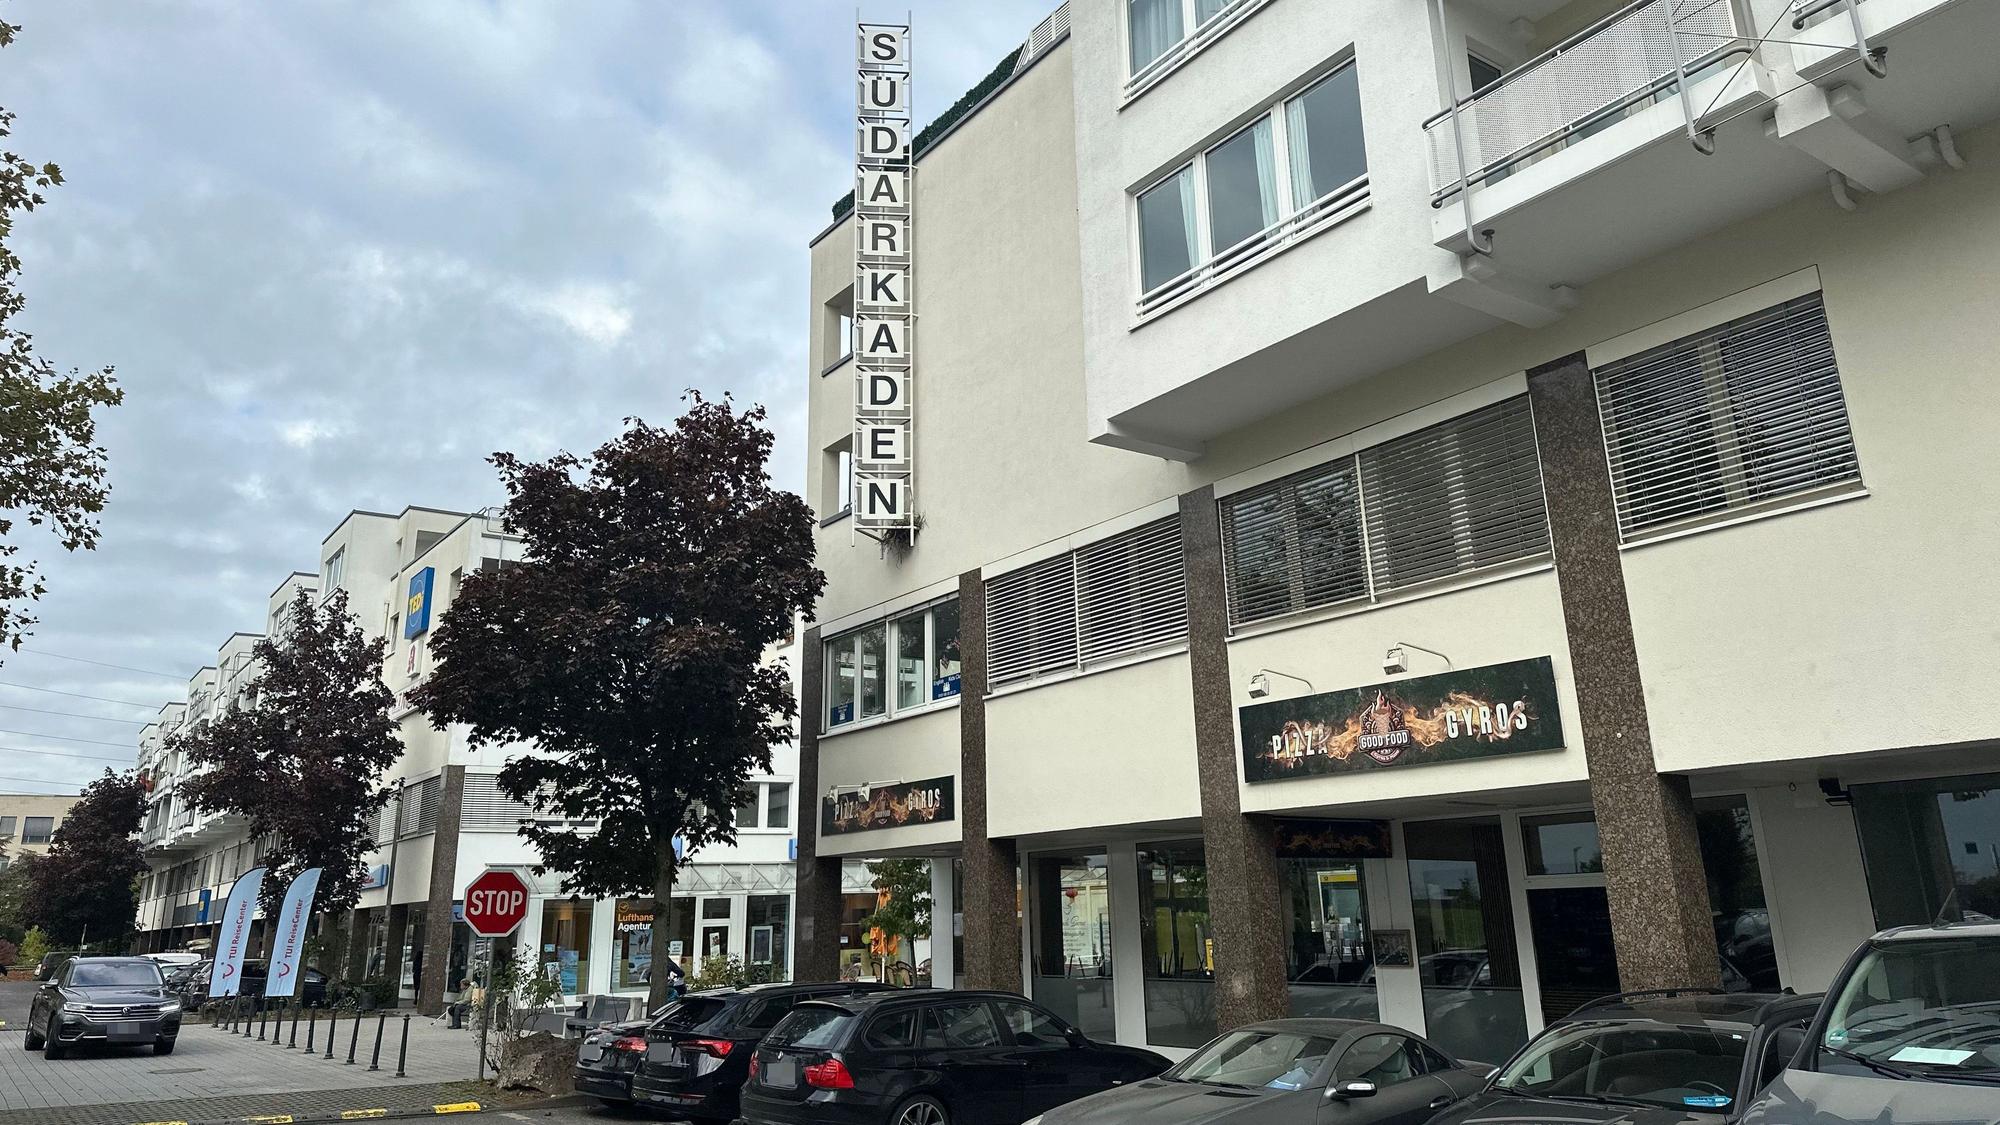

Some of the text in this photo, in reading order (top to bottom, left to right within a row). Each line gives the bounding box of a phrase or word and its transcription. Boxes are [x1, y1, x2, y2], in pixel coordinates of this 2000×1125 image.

[869, 33, 898, 515] SÜDARKADEN
[1445, 700, 1528, 739] GYROS
[1272, 728, 1328, 760] PIZZA
[1361, 731, 1408, 749] GOOD FOOD
[908, 788, 941, 811] GYROS
[470, 890, 523, 915] STOP
[229, 900, 248, 960] TUI ReiseCenter
[285, 898, 304, 959] TUI ReiseCenter
[617, 913, 654, 922] Lufthans
[617, 922, 652, 933] Agentur
